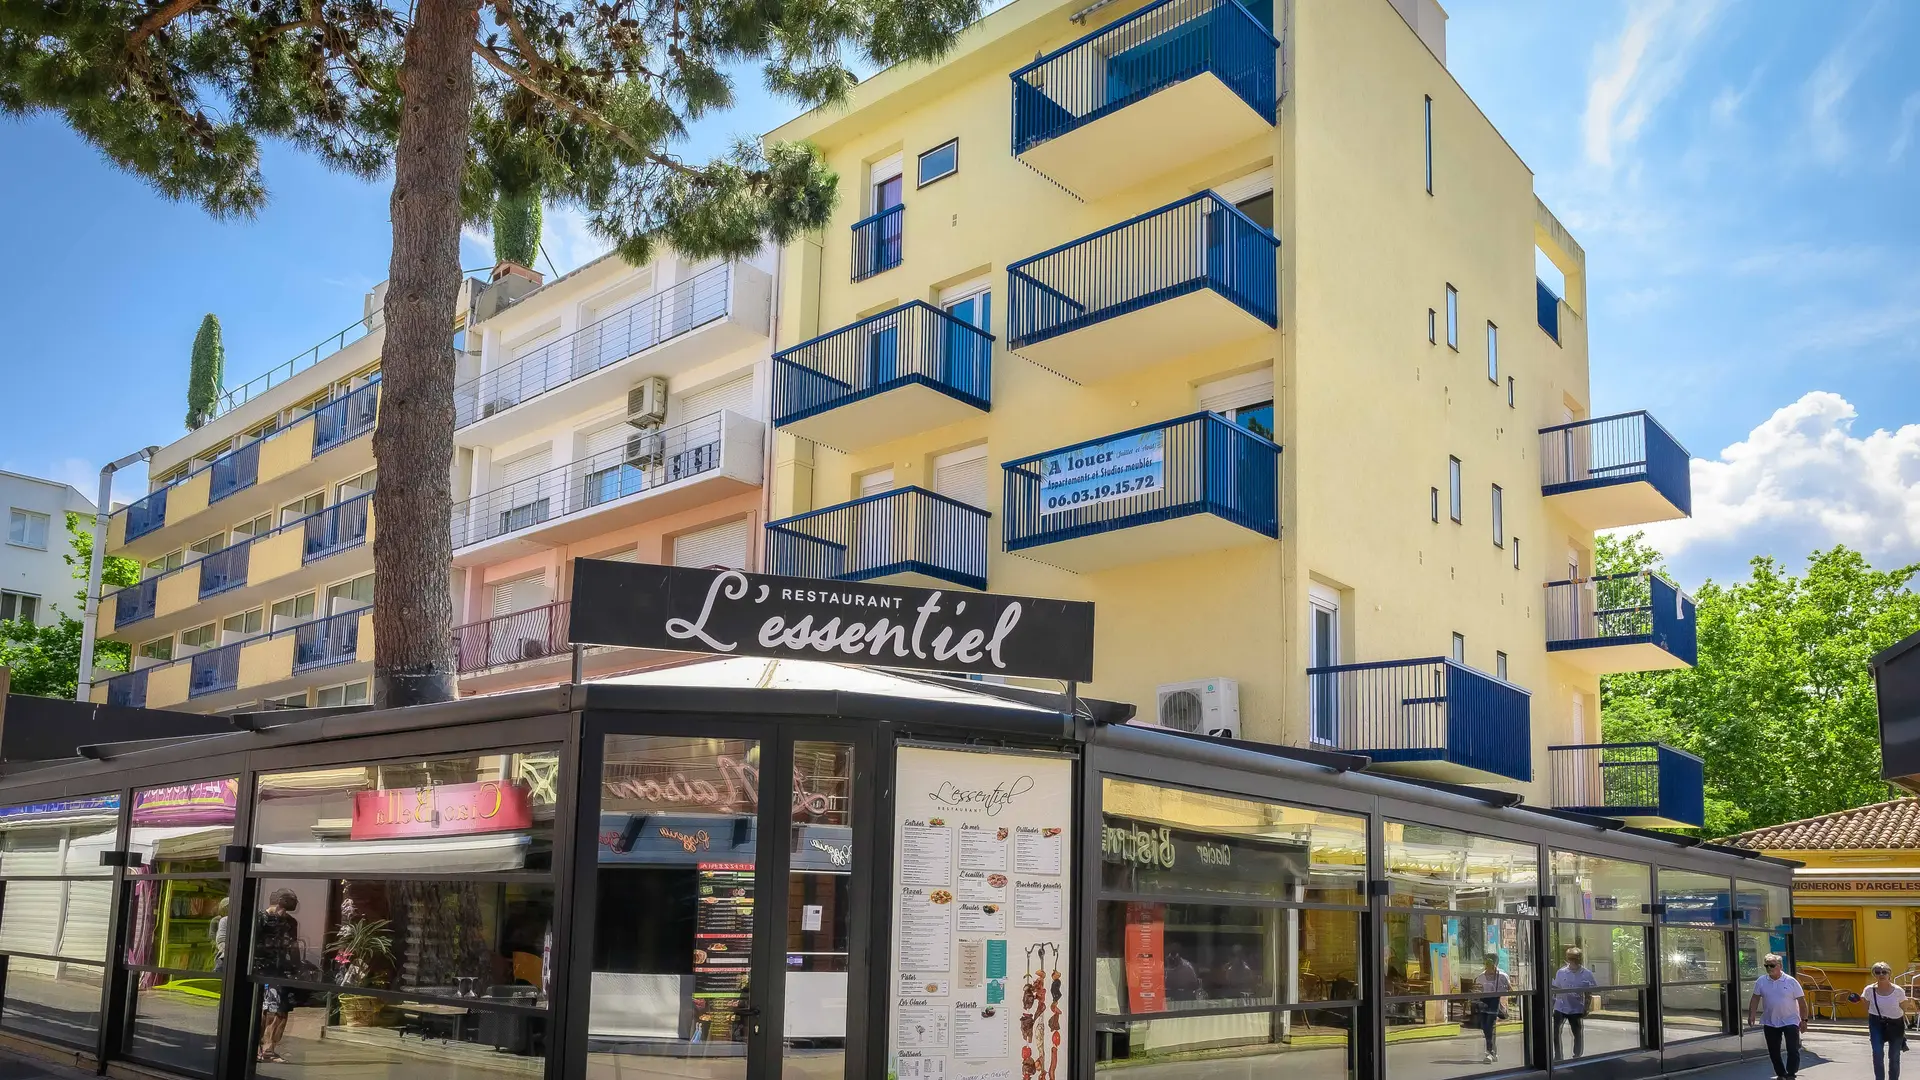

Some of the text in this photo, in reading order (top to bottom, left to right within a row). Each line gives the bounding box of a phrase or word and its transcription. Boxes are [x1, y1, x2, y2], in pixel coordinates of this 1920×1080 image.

[1047, 457, 1153, 490] Appartements et Studios meublés
[1048, 460, 1061, 476] A
[1067, 450, 1114, 472] louer
[1048, 475, 1155, 509] 06.03.19.15.72
[781, 588, 903, 609] RESTAURANT
[665, 570, 1022, 669] L'essentiel
[929, 775, 1035, 817] L'essentiel
